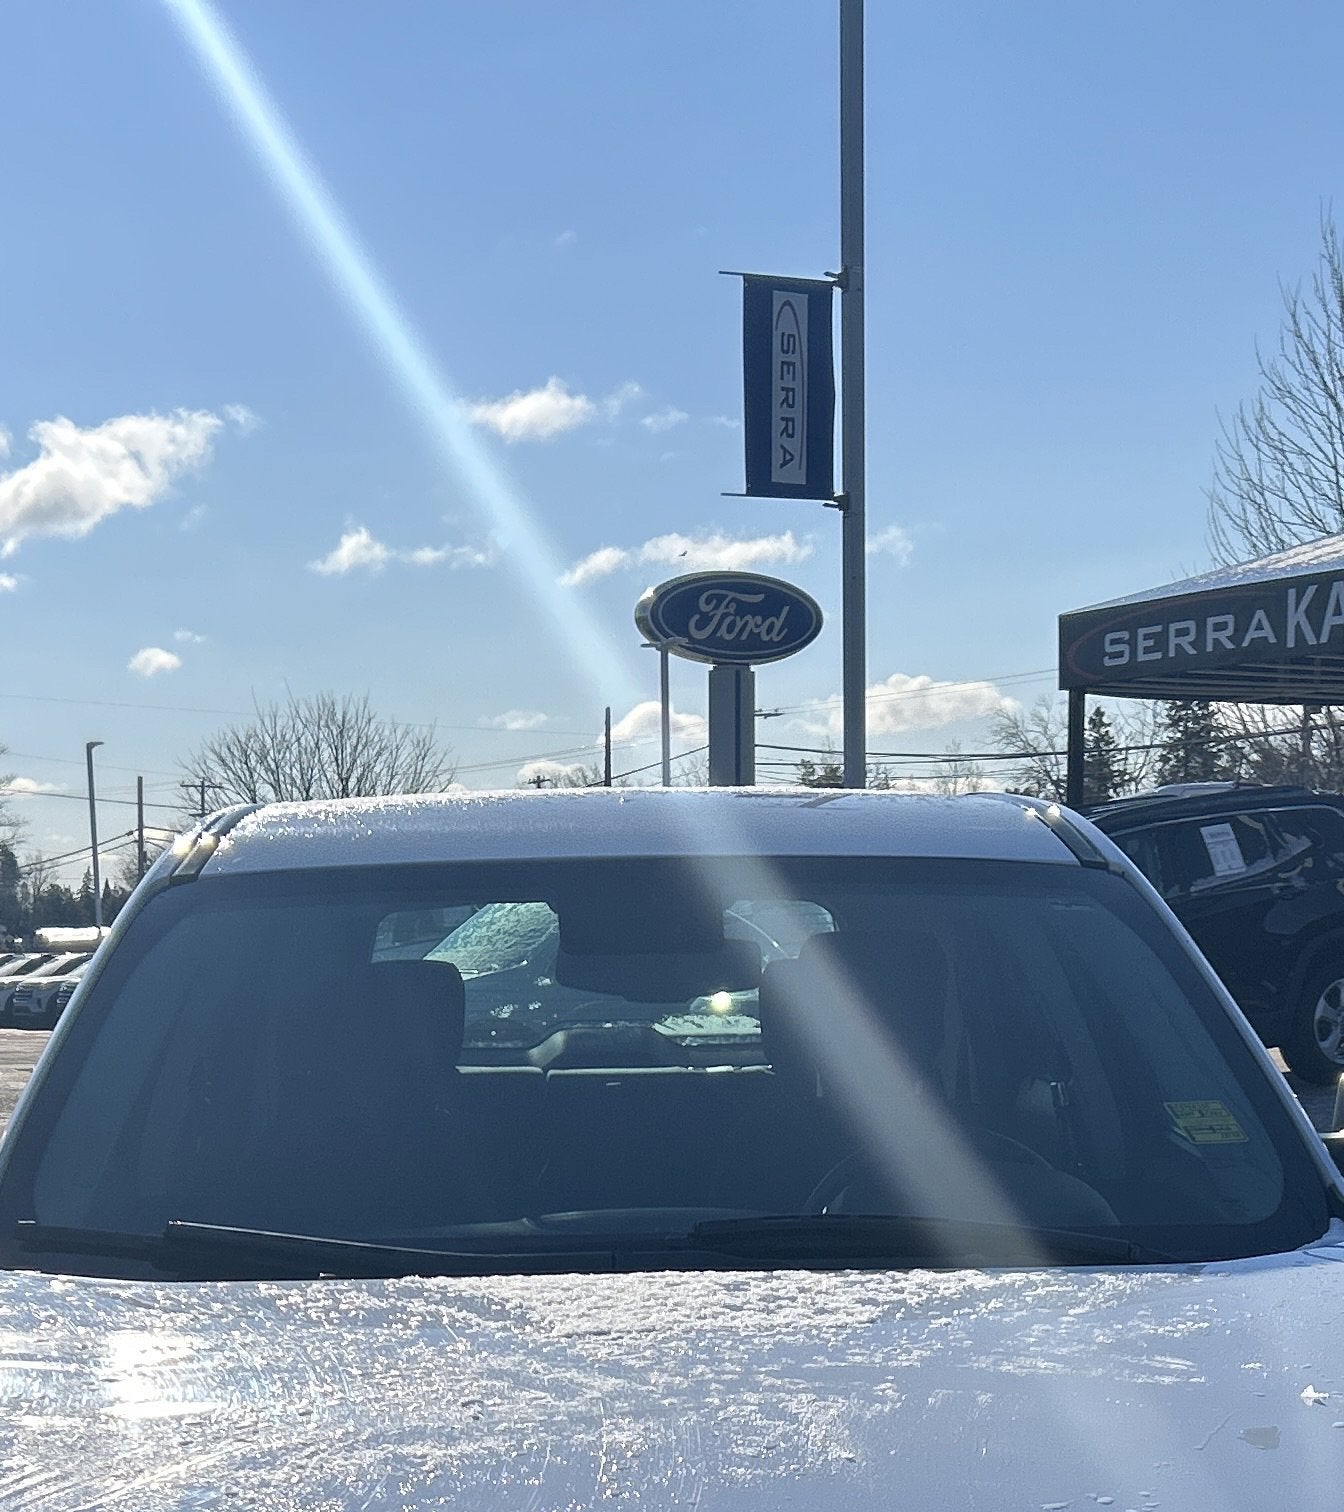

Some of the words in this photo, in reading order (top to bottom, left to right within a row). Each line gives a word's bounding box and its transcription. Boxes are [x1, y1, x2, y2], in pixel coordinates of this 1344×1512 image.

[779, 332, 797, 469] SERRA
[688, 589, 789, 642] Ford
[1102, 609, 1277, 667] SERRA
